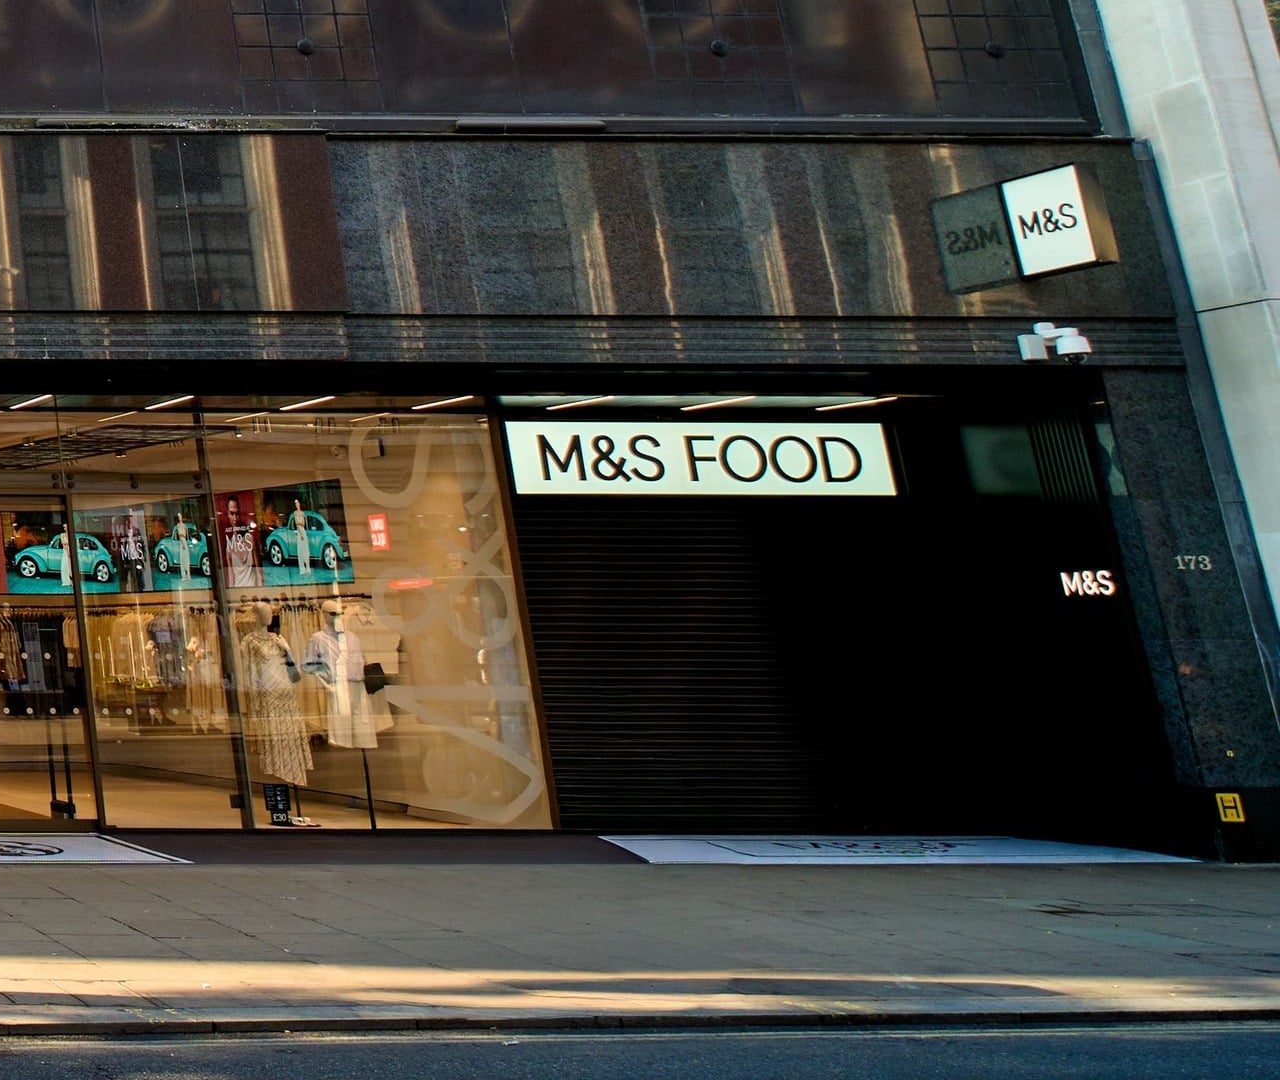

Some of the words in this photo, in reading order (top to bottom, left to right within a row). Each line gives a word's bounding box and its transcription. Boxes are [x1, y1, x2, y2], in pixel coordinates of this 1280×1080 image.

[1017, 203, 1077, 239] M&S
[535, 433, 666, 483] M&S
[682, 434, 863, 483] FOOD
[225, 532, 253, 553] M&S
[1174, 554, 1213, 571] 173
[1059, 569, 1117, 597] M&S
[1219, 796, 1241, 819] H
